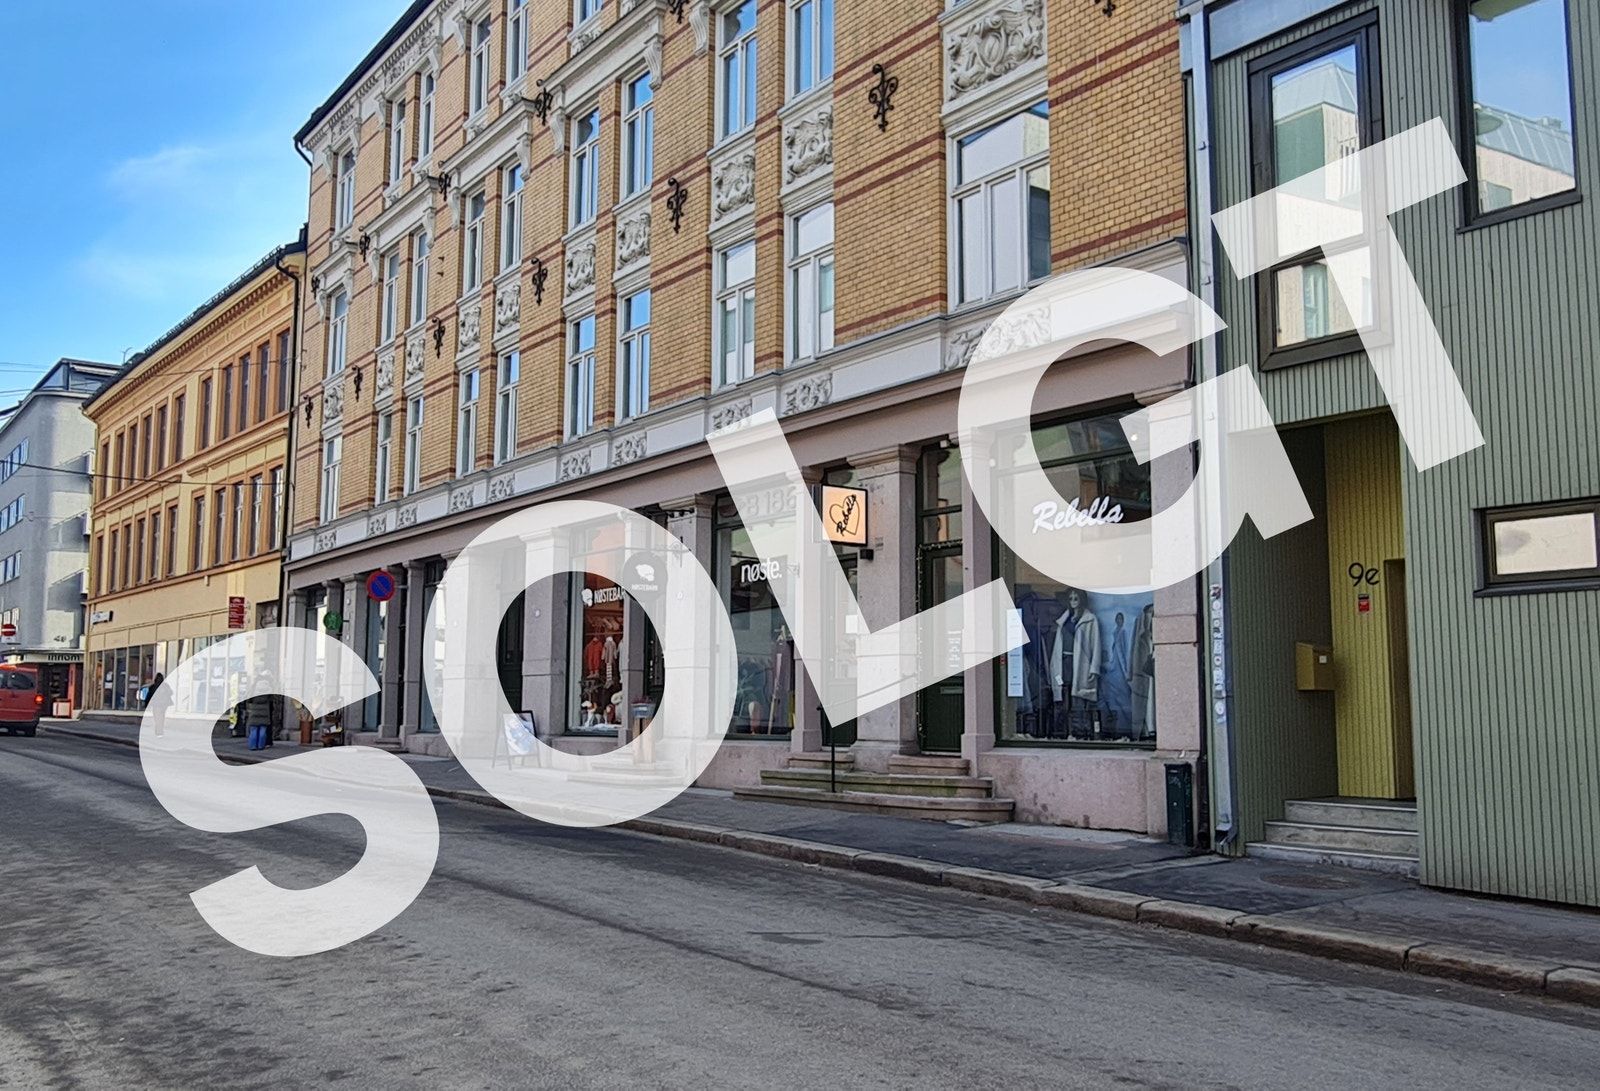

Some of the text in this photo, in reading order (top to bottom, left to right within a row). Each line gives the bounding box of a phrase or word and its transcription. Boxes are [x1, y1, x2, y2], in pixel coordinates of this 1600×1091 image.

[1031, 495, 1125, 534] Rebella
[741, 557, 783, 583] nøste.
[1348, 562, 1380, 587] 9e
